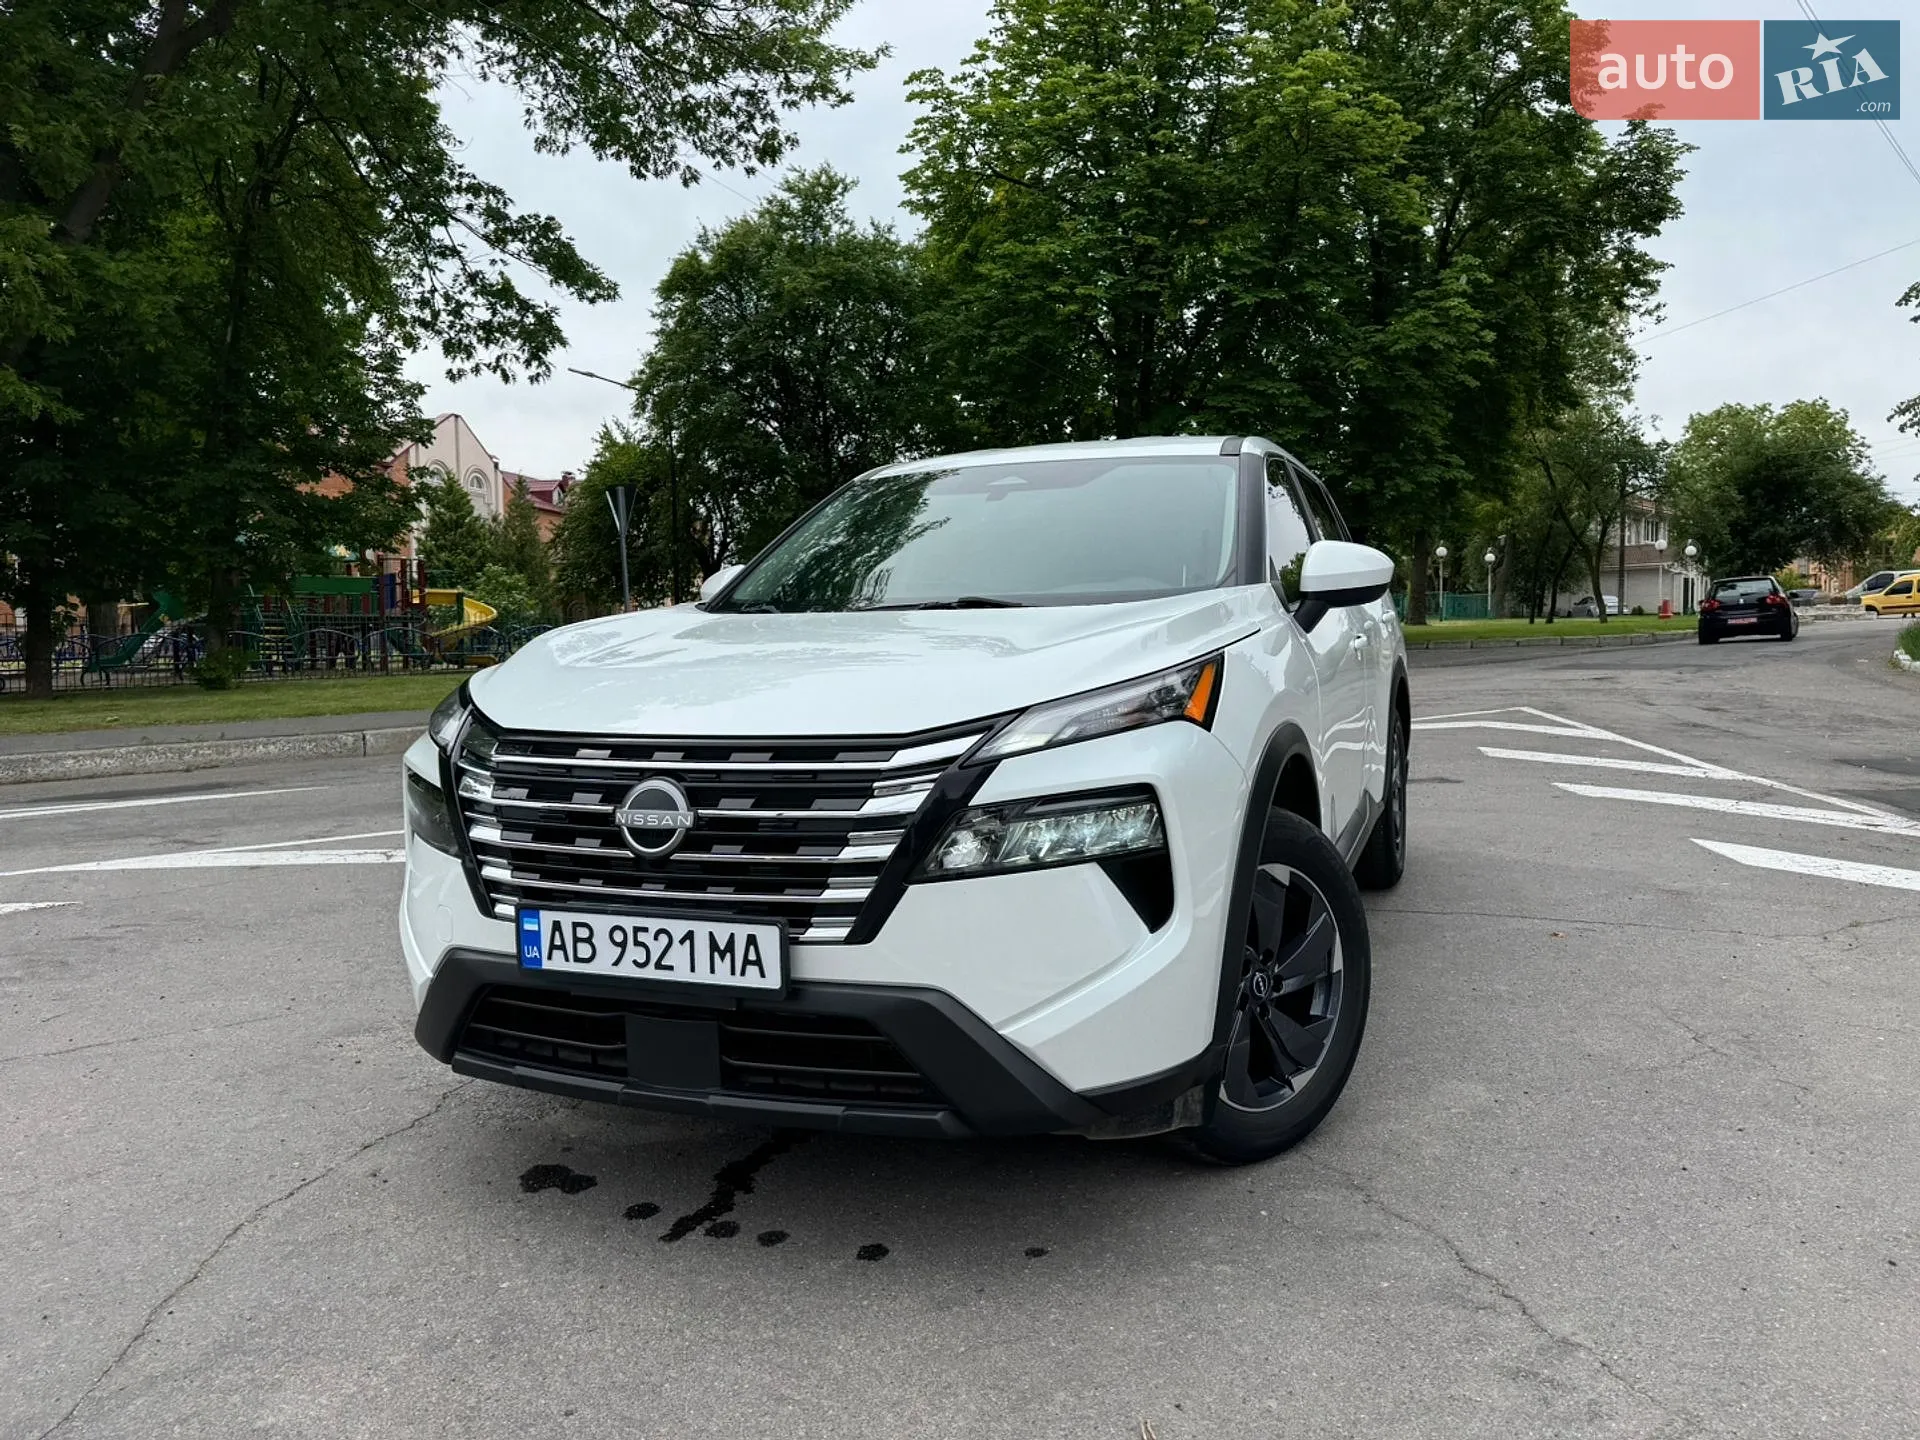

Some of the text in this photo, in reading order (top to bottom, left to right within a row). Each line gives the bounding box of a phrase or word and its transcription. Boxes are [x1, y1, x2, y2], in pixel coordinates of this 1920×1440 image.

[616, 812, 691, 826] NISSAN
[524, 945, 541, 959] UA
[547, 920, 766, 979] AB 9521 MA
